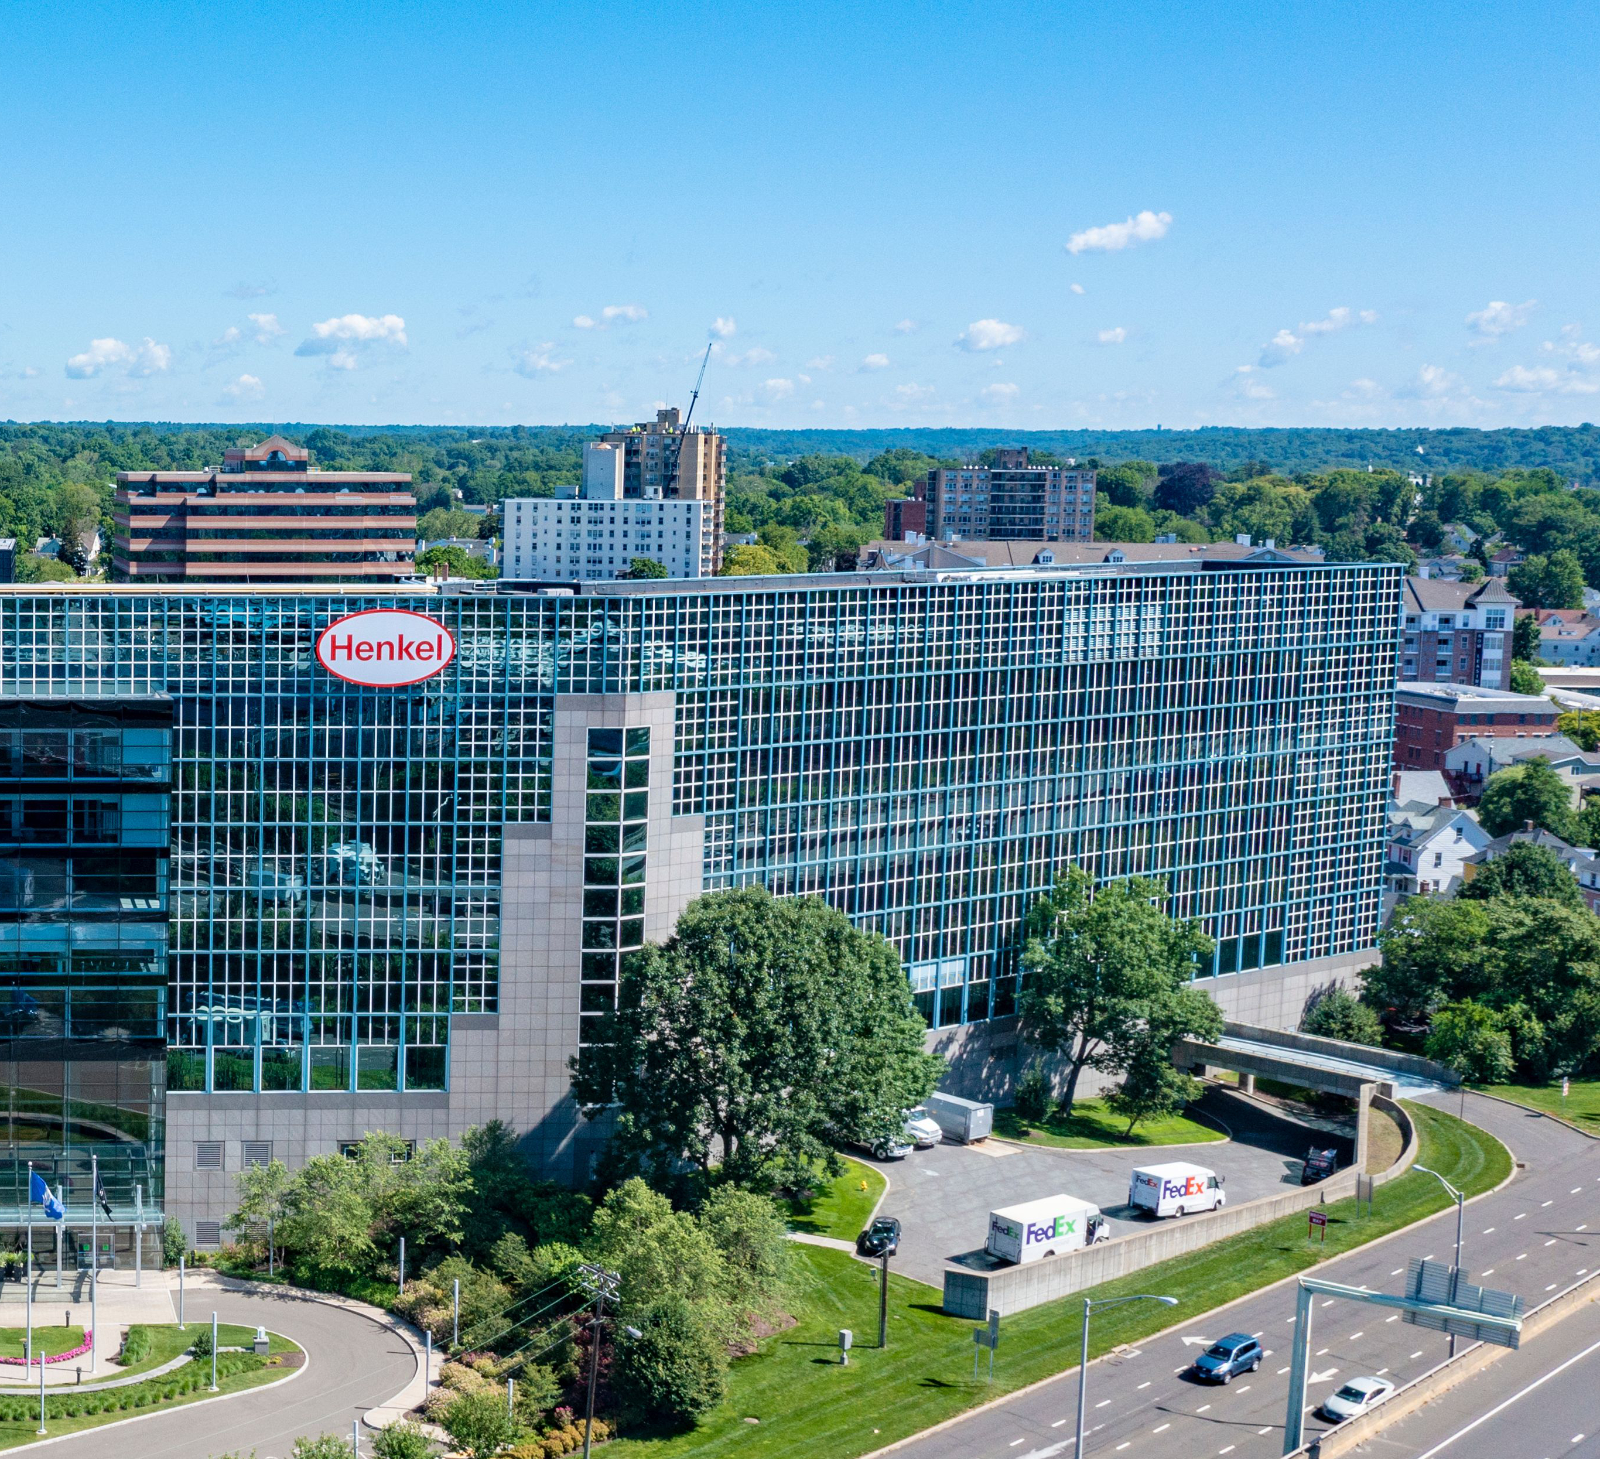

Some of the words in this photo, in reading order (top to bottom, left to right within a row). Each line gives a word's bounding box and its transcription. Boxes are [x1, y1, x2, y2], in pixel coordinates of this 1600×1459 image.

[330, 634, 443, 661] Henkel
[1136, 1175, 1158, 1188] FedEx
[1163, 1176, 1205, 1200] FedEx
[992, 1220, 1020, 1240] FedEx
[1026, 1215, 1077, 1245] FedEx
